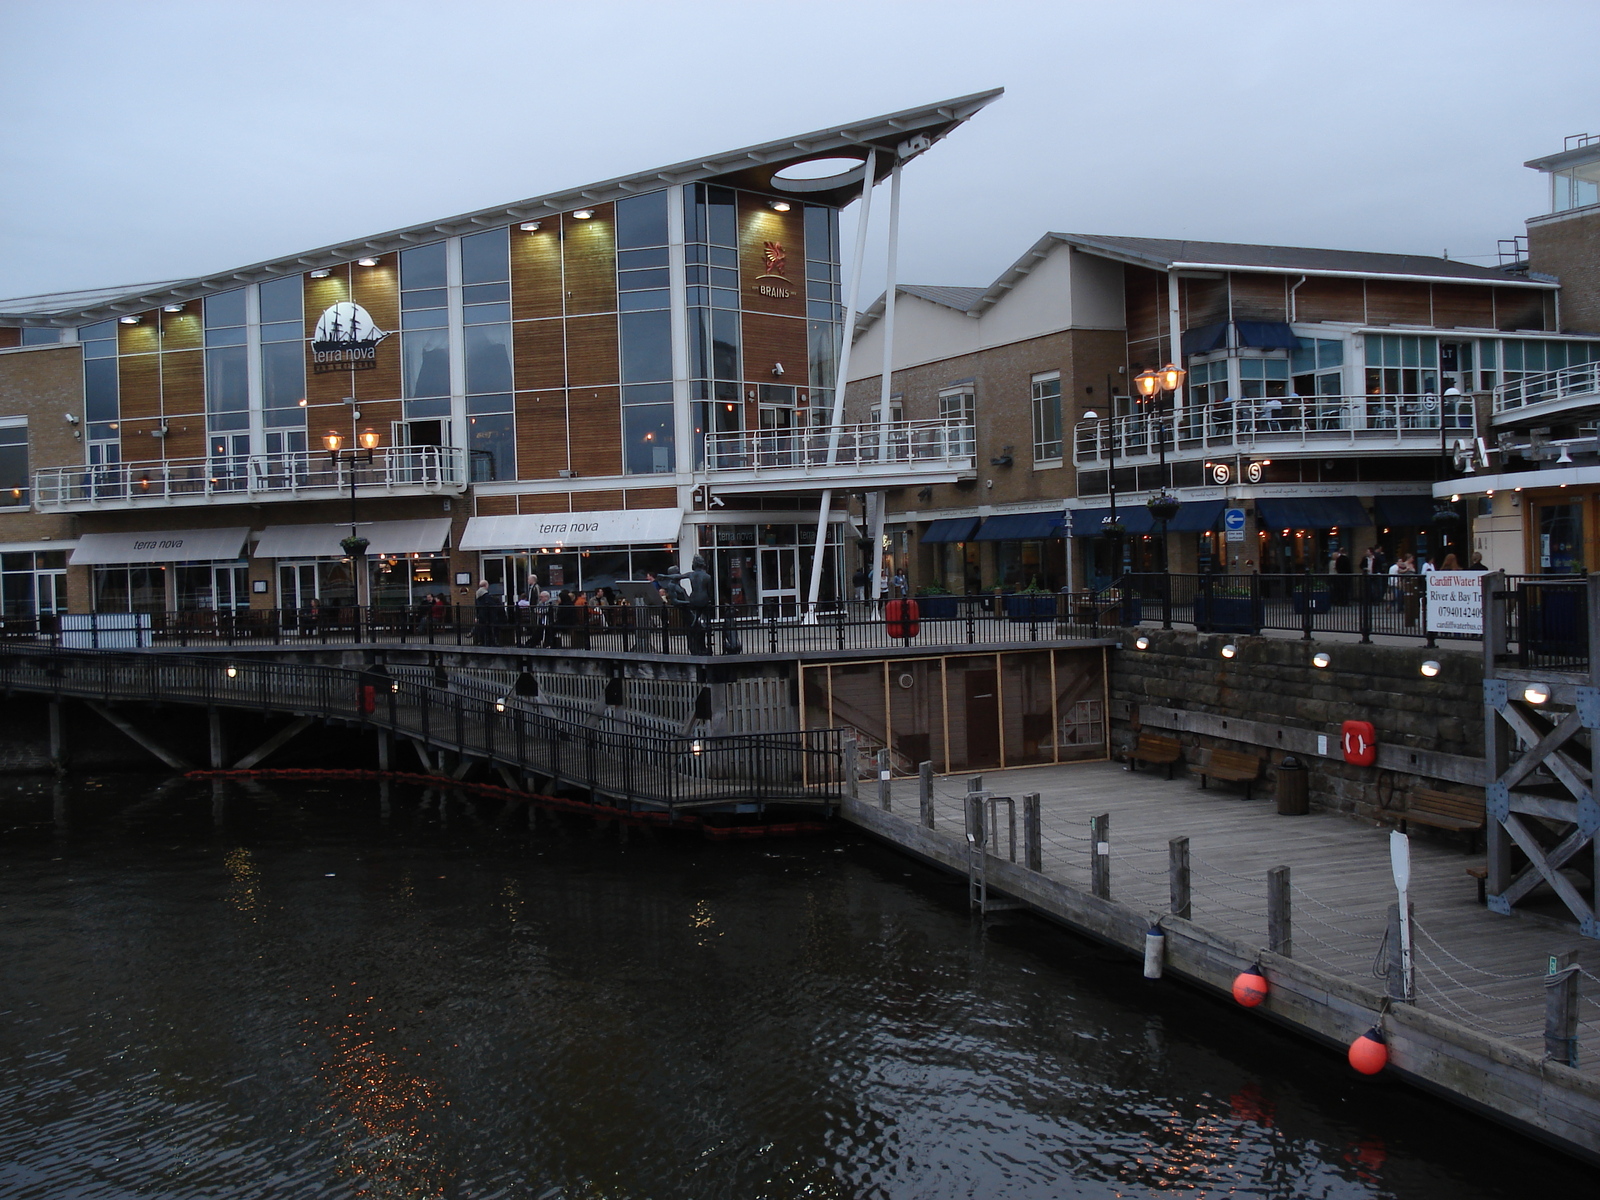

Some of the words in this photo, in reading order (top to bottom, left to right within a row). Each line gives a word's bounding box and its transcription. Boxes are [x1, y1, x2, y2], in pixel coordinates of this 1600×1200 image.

[760, 285, 790, 298] BRAINS
[313, 349, 342, 363] terra
[346, 347, 375, 360] nova
[1216, 466, 1227, 481] S
[1250, 465, 1260, 480] S
[1102, 516, 1121, 524] SAT
[540, 523, 567, 534] terra
[570, 522, 599, 532] nova
[717, 531, 735, 541] terra
[133, 540, 157, 550] terra
[158, 540, 184, 549] nova
[1429, 575, 1453, 587] Cardiff
[1453, 575, 1475, 587] Water
[1430, 591, 1449, 601] River
[1450, 591, 1456, 601] &
[1458, 592, 1471, 605] Bay
